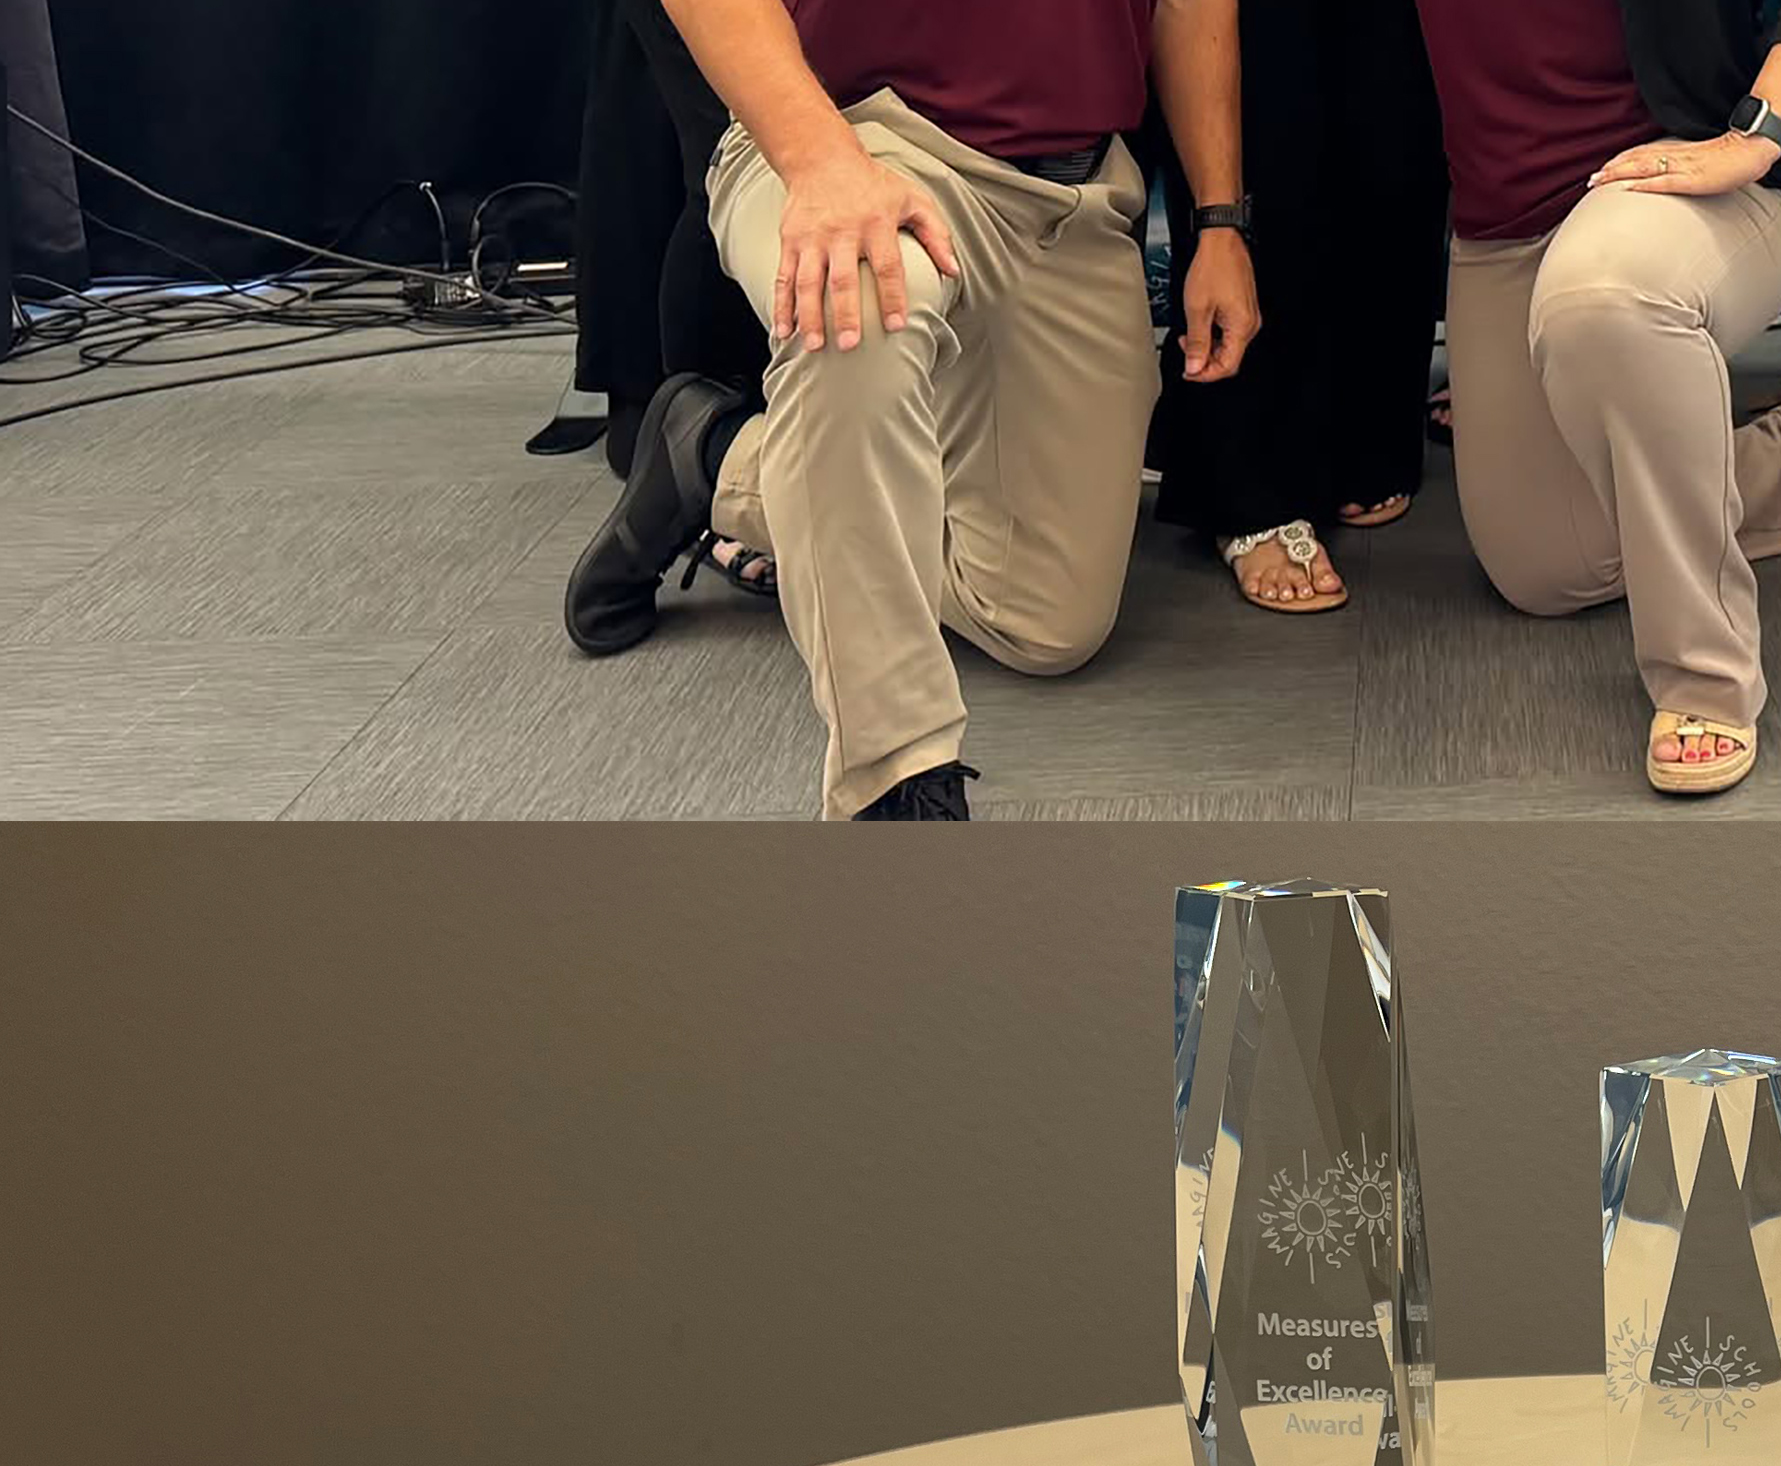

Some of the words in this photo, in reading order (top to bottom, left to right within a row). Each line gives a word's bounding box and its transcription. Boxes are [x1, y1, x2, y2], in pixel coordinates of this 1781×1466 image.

[1257, 1312, 1379, 1339] Measures
[1306, 1346, 1333, 1371] of
[1256, 1379, 1389, 1404] Excellence
[1284, 1412, 1364, 1436] Award
